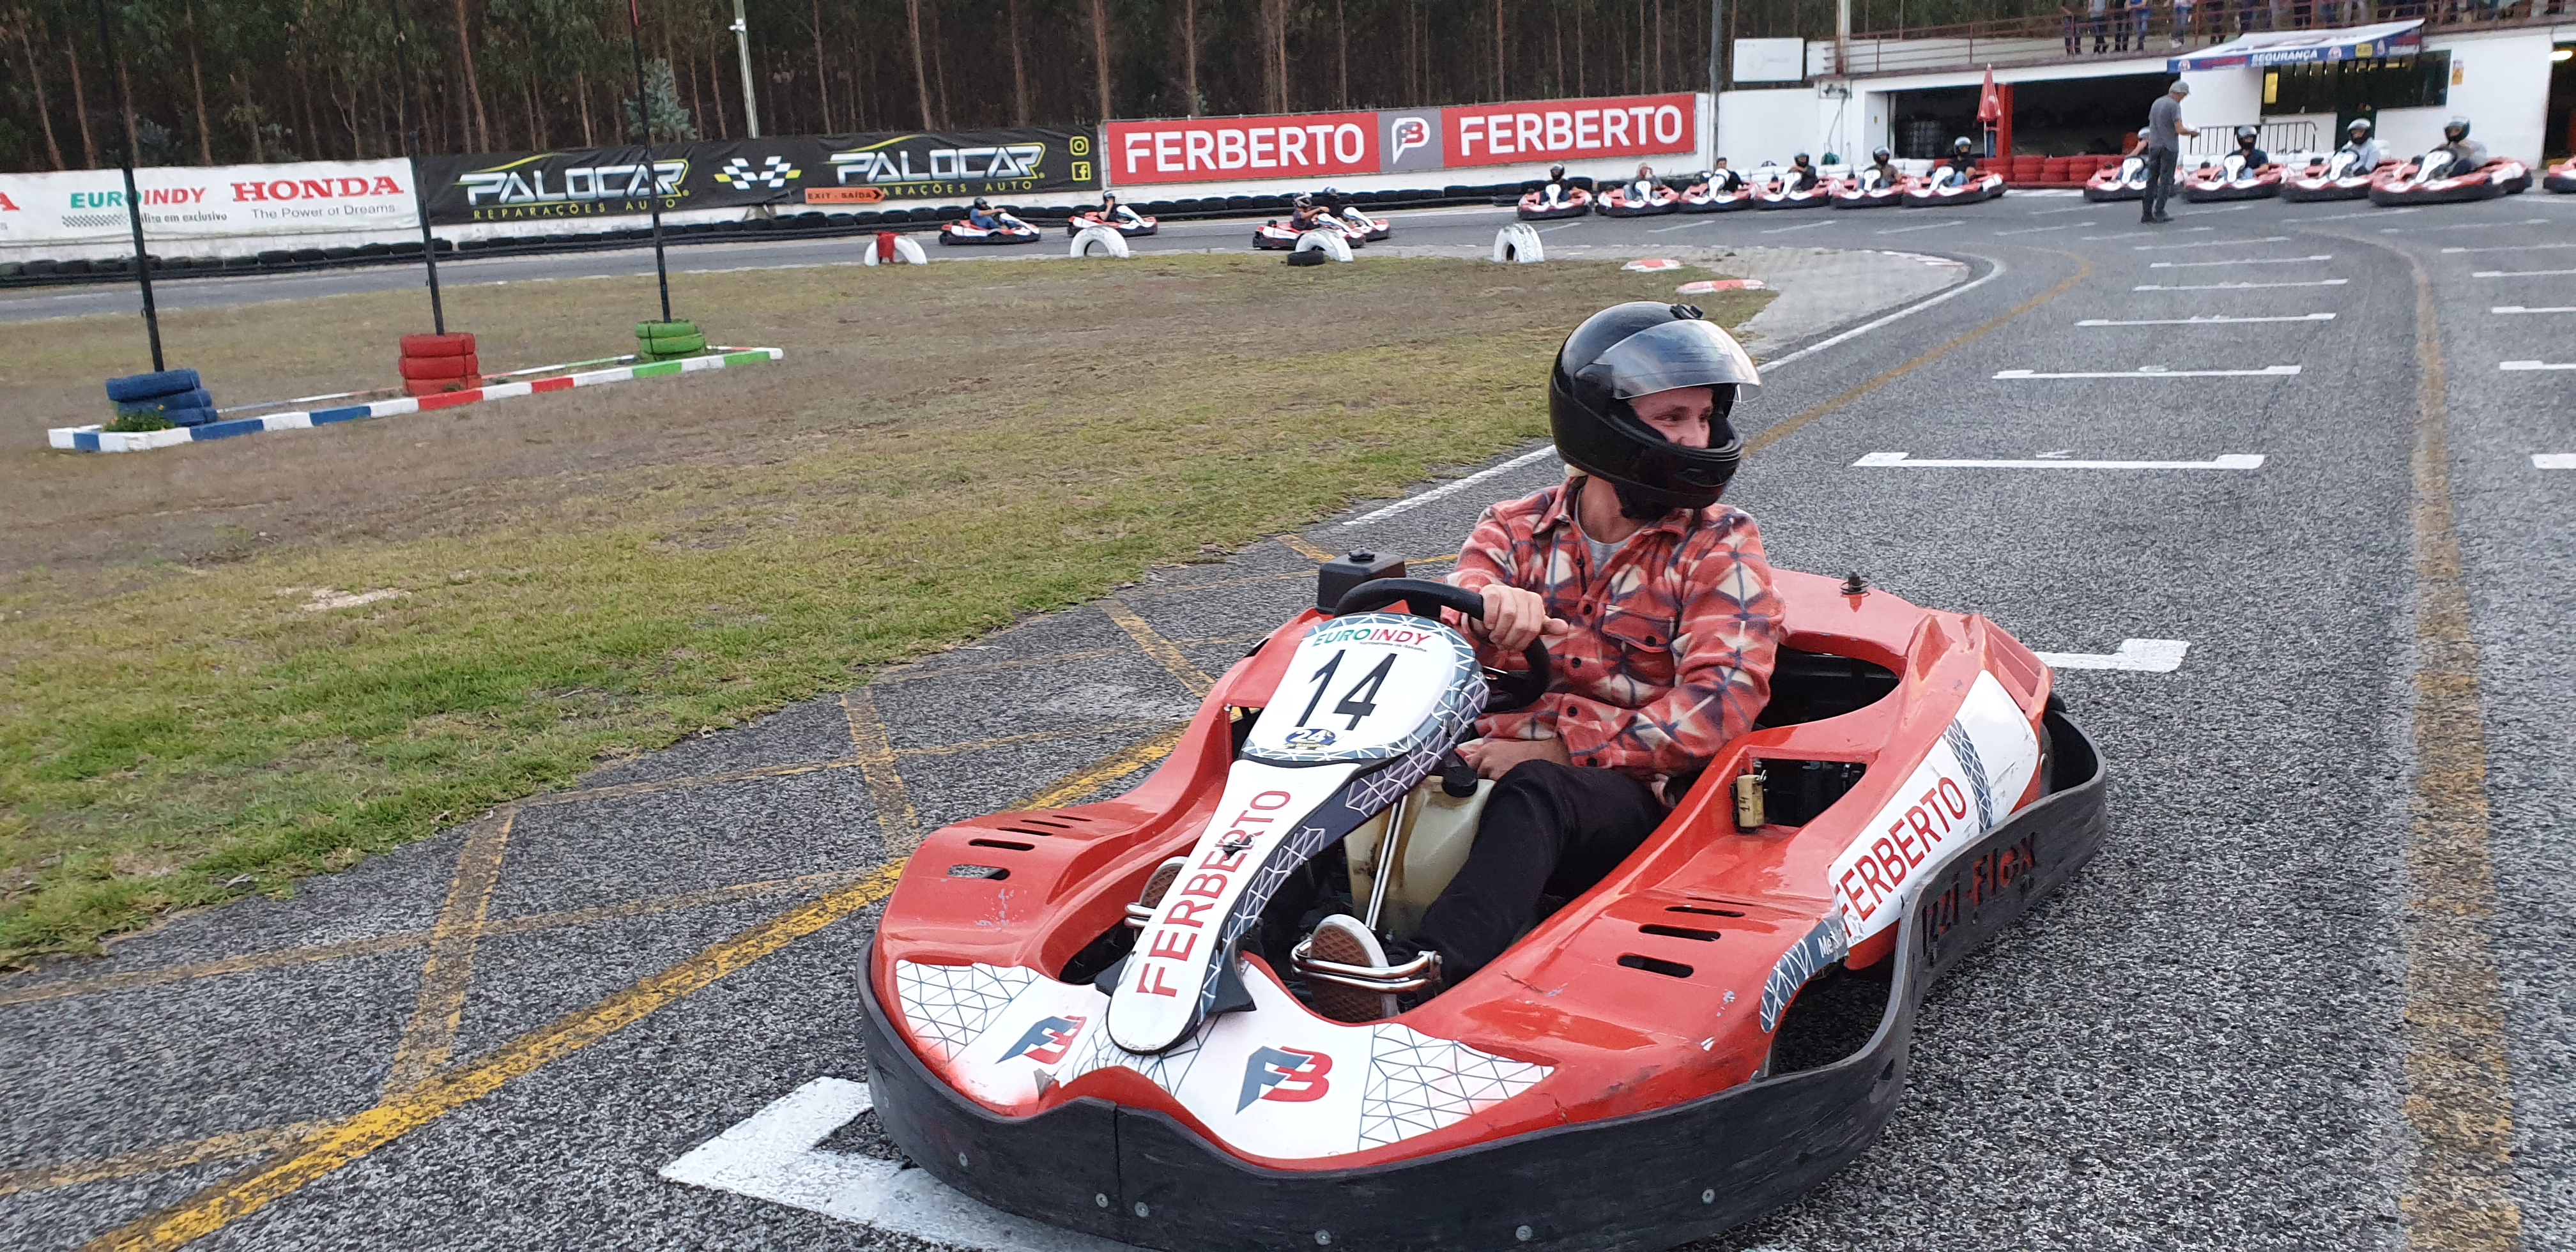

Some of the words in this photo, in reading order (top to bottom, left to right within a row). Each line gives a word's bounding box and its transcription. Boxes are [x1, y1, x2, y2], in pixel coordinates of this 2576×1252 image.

[1459, 105, 1683, 157] FERBERTO
[1124, 123, 1365, 174] FERBERTO
[830, 145, 1042, 185] PALOCAR
[230, 176, 404, 202] HONDA
[459, 162, 686, 206] PALOCAR
[985, 180, 1032, 192] AUTO
[841, 191, 872, 200] SAÍDA
[251, 208, 277, 220] The
[281, 206, 323, 218] Power
[328, 206, 341, 216] of
[344, 203, 395, 215] Dreams
[625, 199, 676, 211] AUO
[164, 214, 180, 222] em
[183, 210, 227, 222] exclusivo
[1312, 629, 1432, 647] EUROINDY
[1295, 649, 1398, 731] 14
[1289, 729, 1328, 742] 24
[1739, 796, 1751, 812] 14
[1135, 790, 1291, 998] FERBERTO
